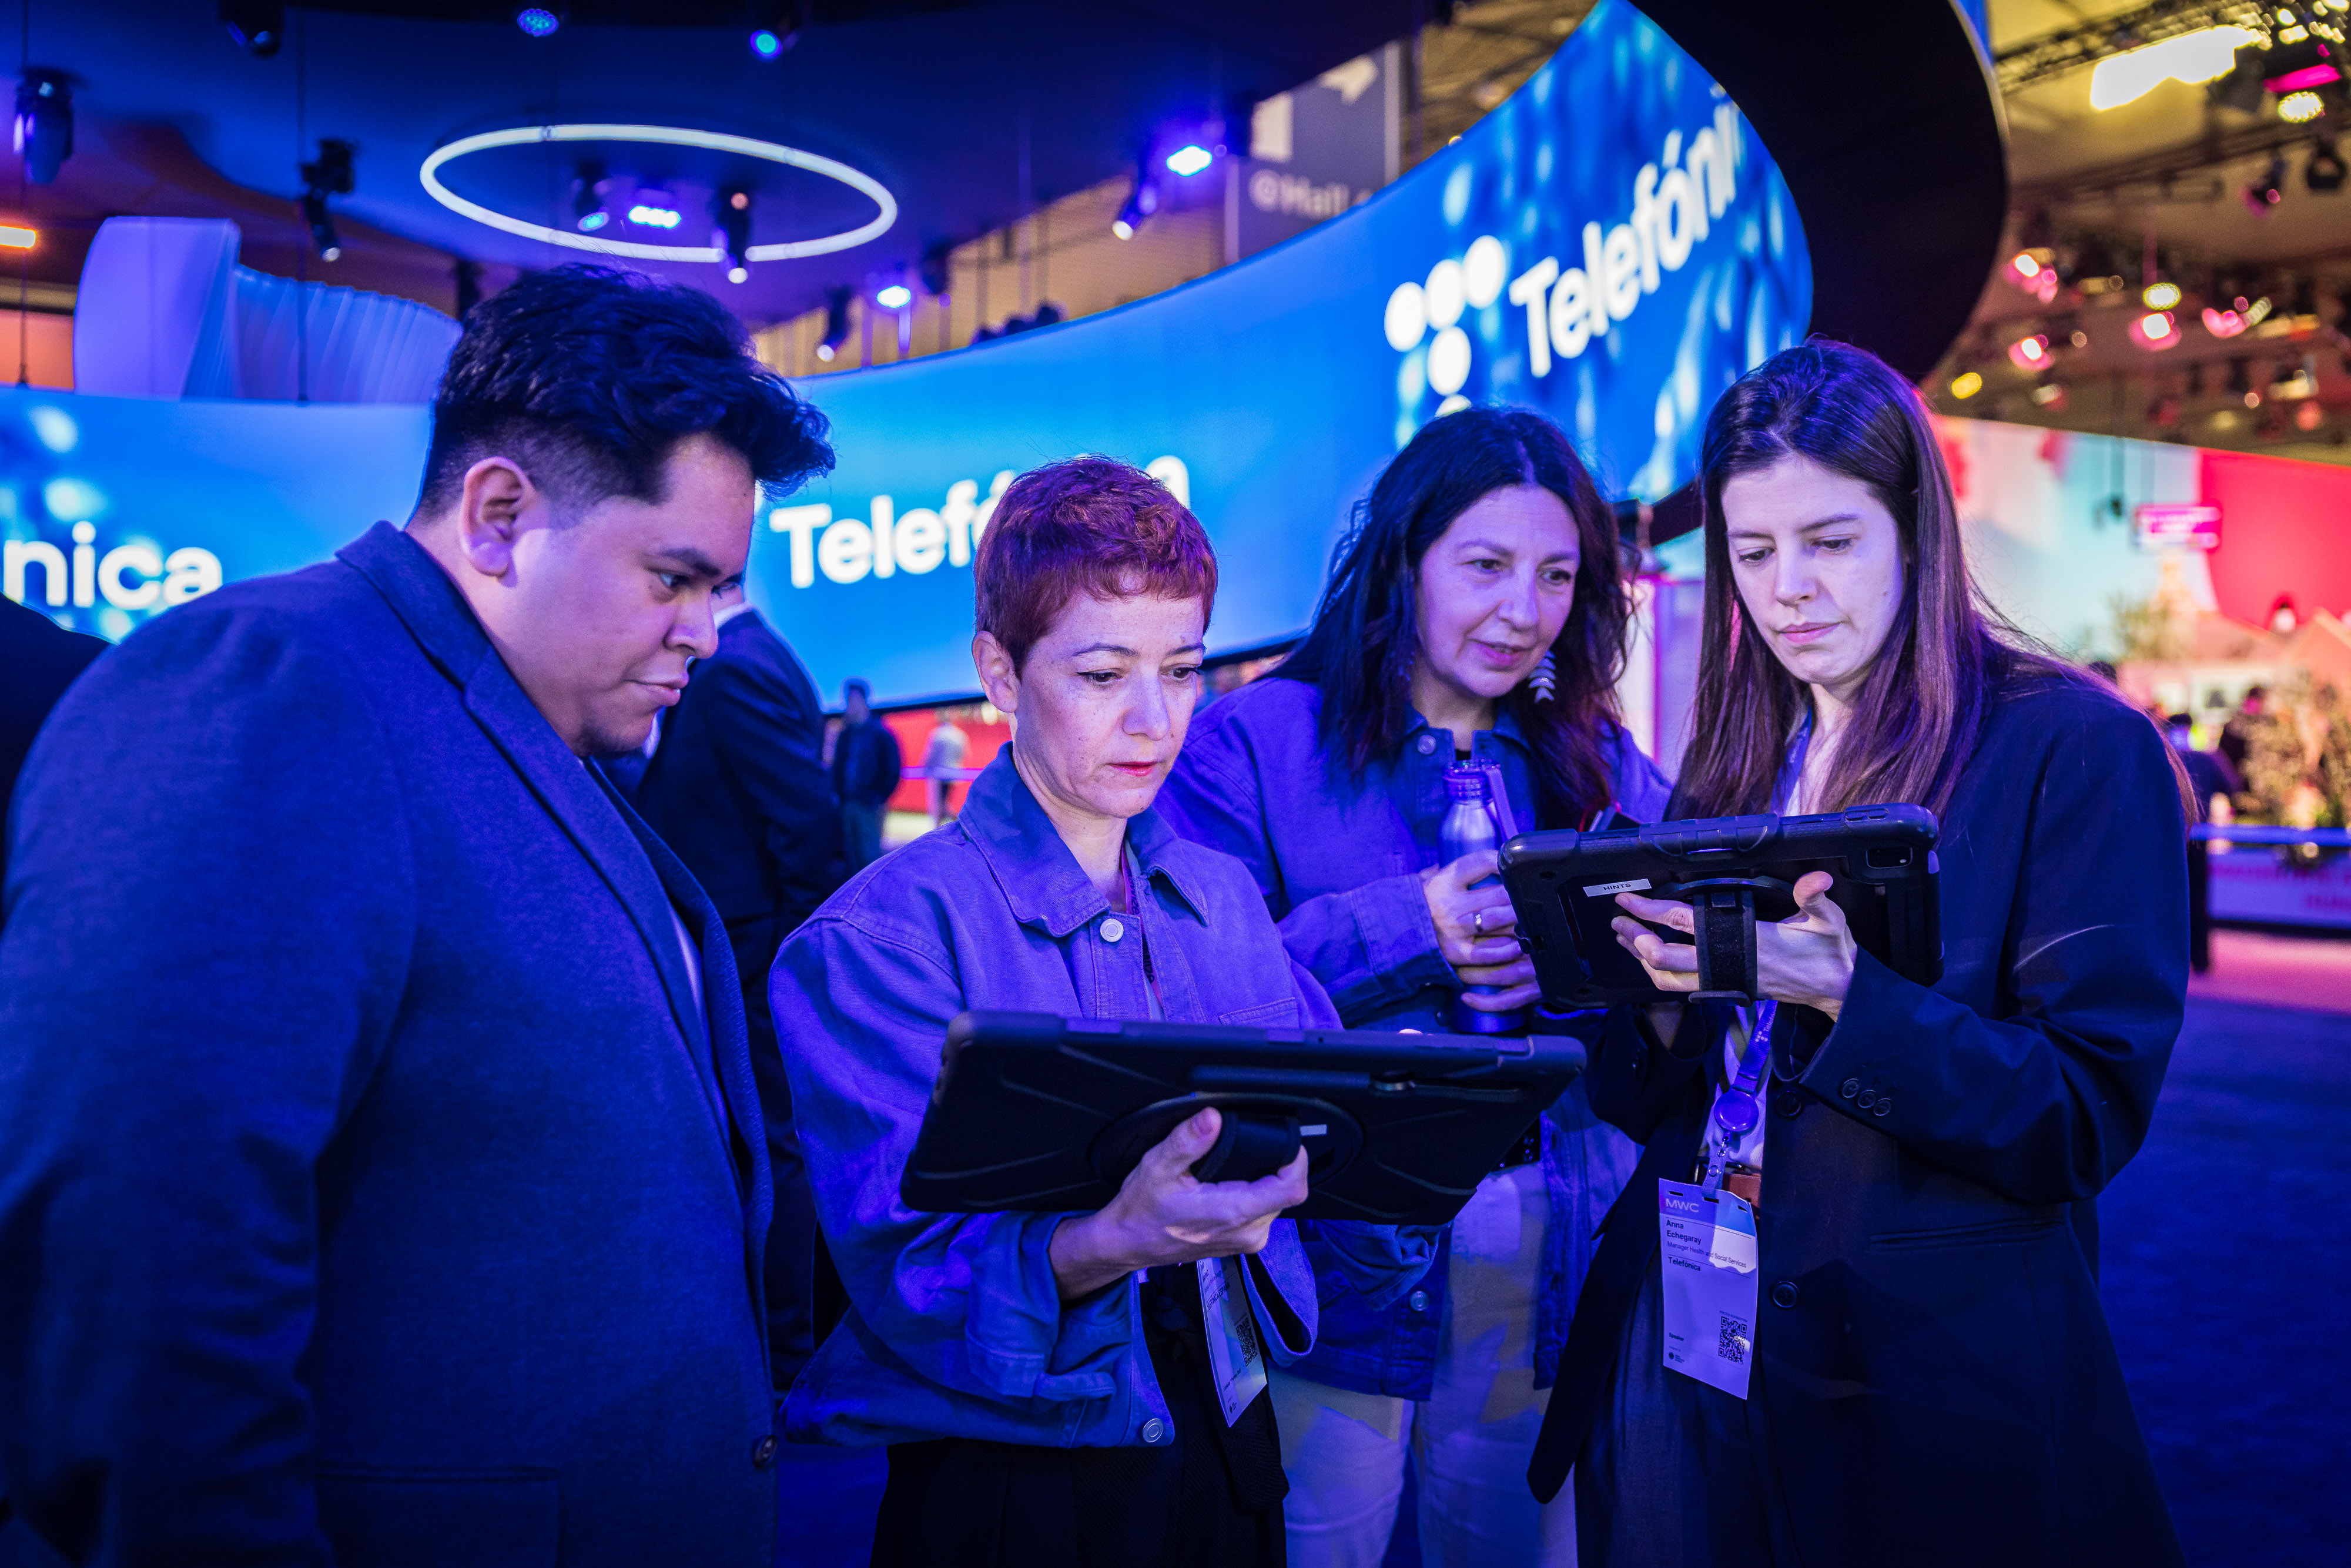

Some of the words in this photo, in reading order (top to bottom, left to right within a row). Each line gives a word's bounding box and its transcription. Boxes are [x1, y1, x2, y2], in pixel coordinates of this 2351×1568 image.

[1509, 103, 1740, 378] Telefóni
[1603, 883, 1631, 891] HINTS
[1666, 1198, 1699, 1212] MWC
[1666, 1219, 1684, 1229] Anna
[1667, 1230, 1702, 1245] Echegaray
[1667, 1241, 1689, 1251] Manager
[1690, 1245, 1704, 1255] Health
[1714, 1253, 1728, 1262] Social
[1728, 1257, 1747, 1268] Services
[1668, 1257, 1701, 1271] Telefónica
